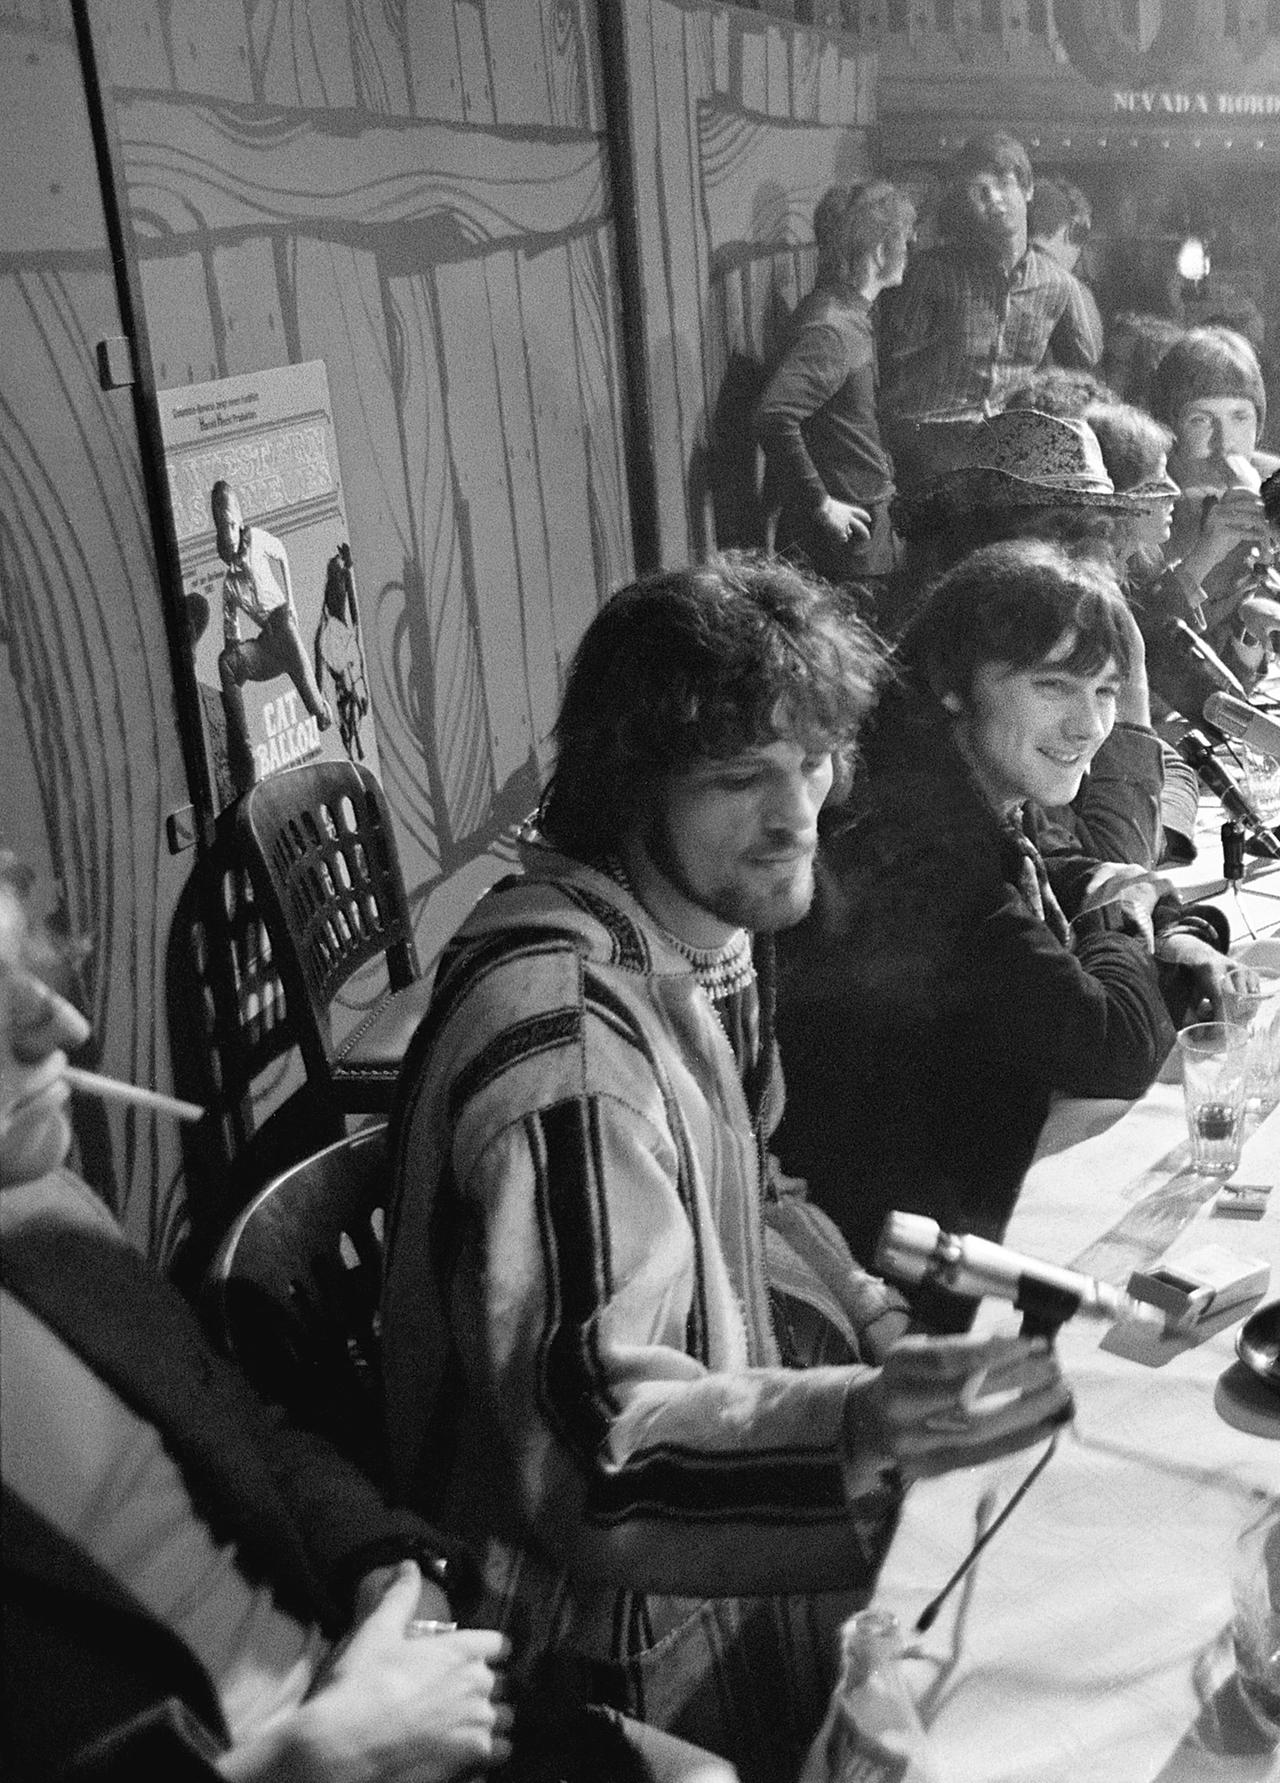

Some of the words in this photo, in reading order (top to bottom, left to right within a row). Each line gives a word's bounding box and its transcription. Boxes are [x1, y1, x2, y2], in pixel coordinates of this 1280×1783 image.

[1113, 92, 1208, 114] NEVADA
[263, 690, 298, 738] CAT
[256, 715, 321, 777] BALLOU
